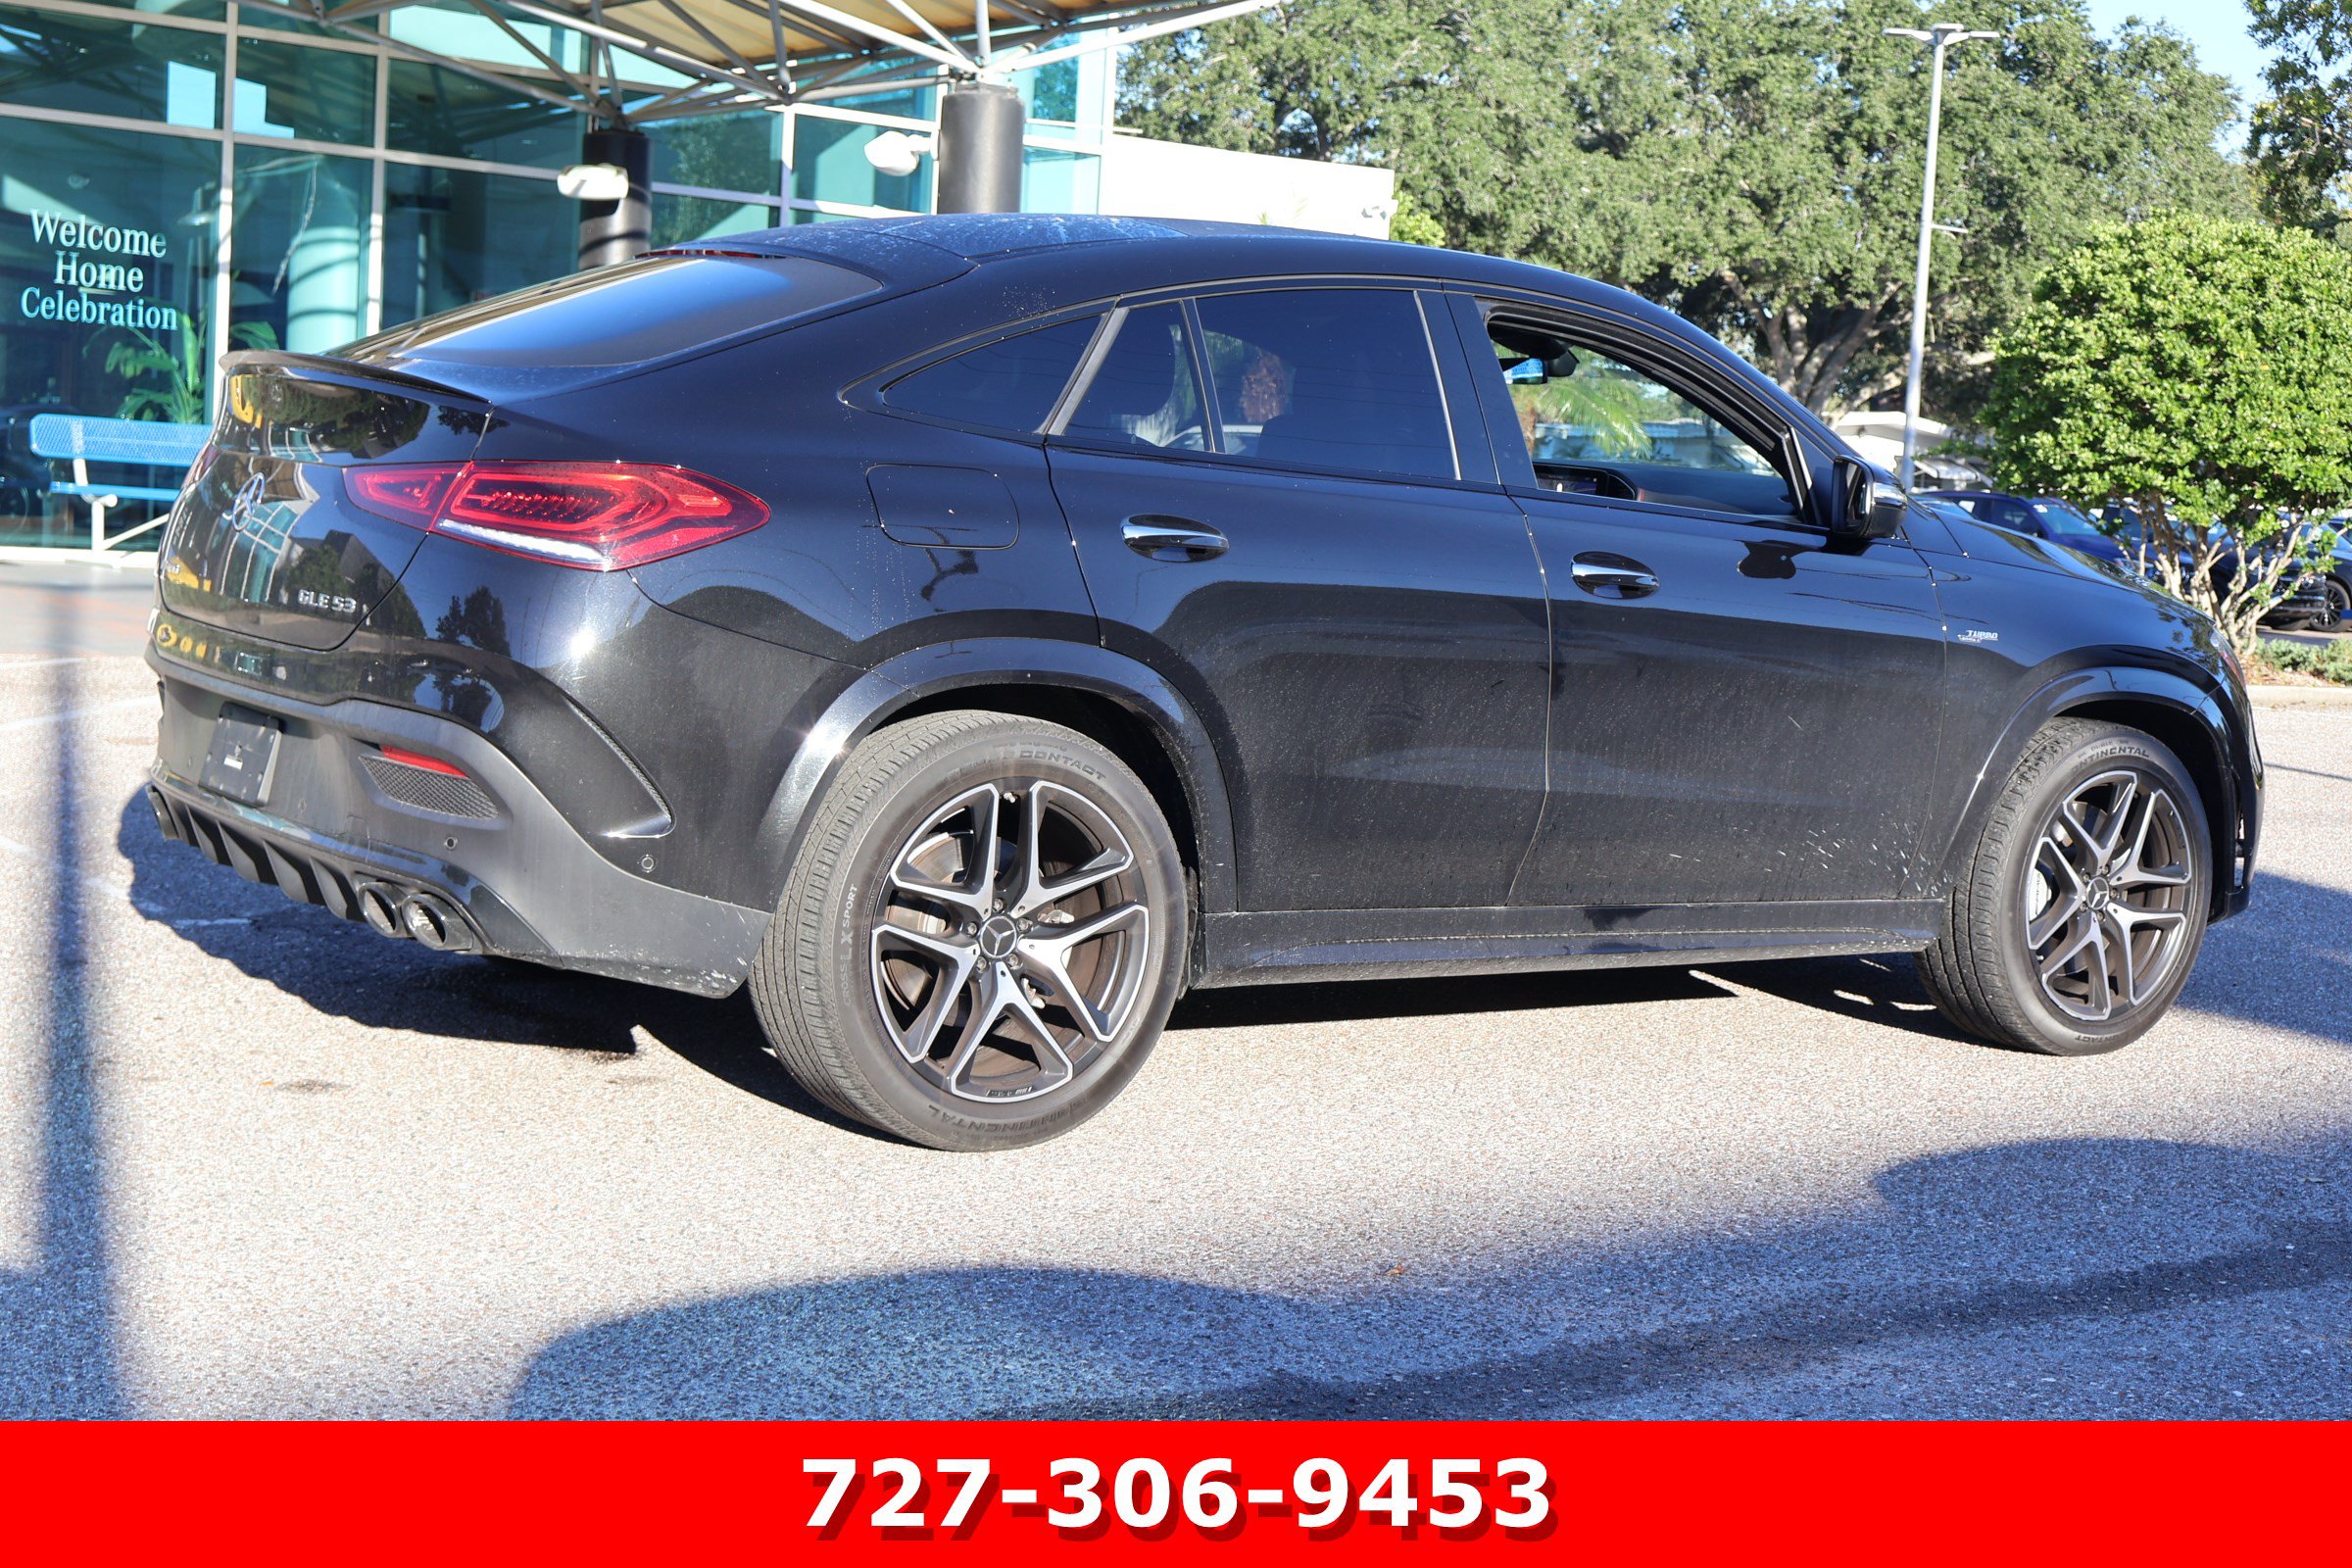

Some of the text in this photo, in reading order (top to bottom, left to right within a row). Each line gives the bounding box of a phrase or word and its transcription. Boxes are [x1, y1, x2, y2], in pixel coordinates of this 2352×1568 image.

[30, 209, 168, 258] Welcome
[54, 250, 144, 293] Home
[21, 286, 177, 331] Celebration
[298, 589, 357, 612] GLE 53
[1966, 629, 1999, 640] TURBO
[1019, 750, 1106, 781] CONTACT
[2070, 746, 2150, 773] ONTINENTAL
[842, 883, 858, 928] SPORT
